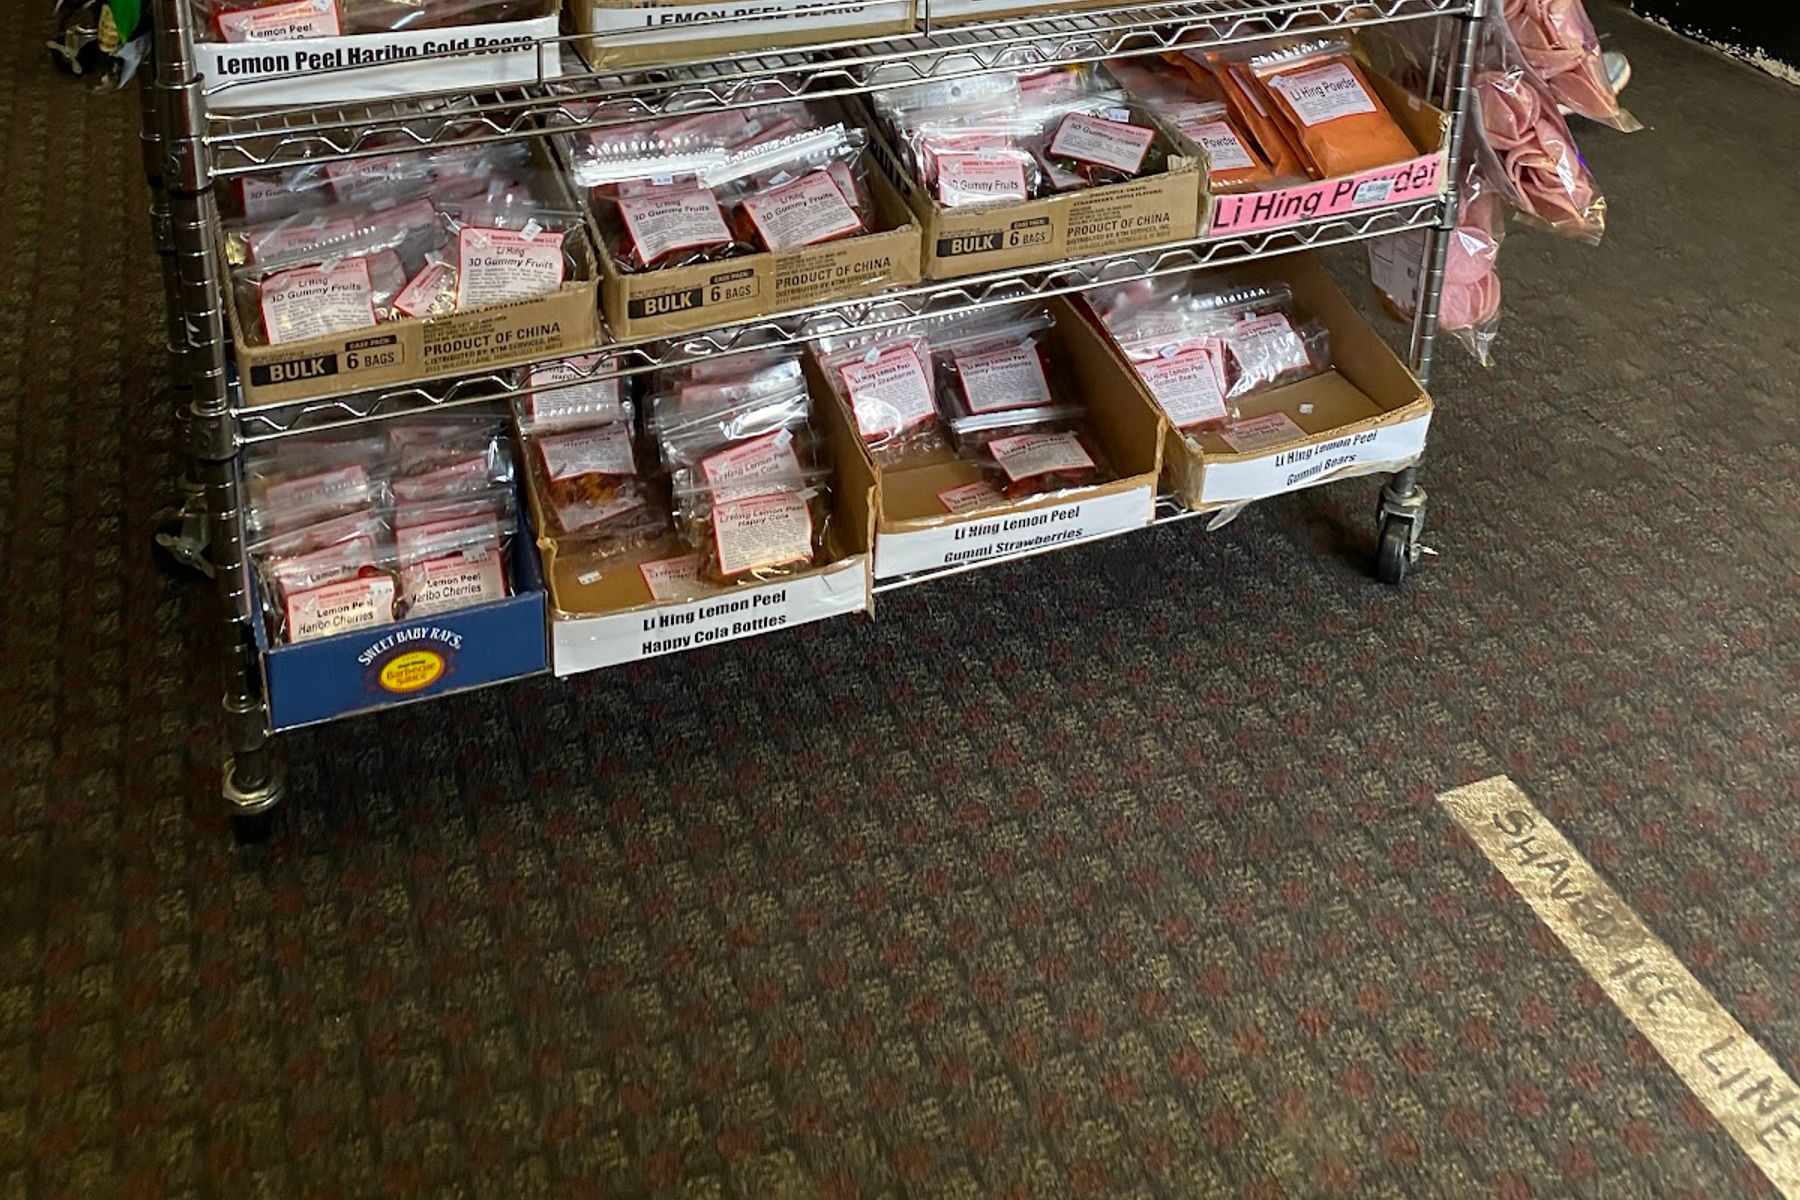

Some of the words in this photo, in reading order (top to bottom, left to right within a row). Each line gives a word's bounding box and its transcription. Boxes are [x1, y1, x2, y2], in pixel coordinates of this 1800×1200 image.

[250, 28, 288, 39] Lemon
[289, 22, 313, 35] Peel
[217, 53, 290, 75] Lemon
[295, 49, 344, 69] Peel
[348, 42, 417, 66] Haribo
[423, 38, 469, 58] Gold
[1290, 90, 1301, 101] Li
[1300, 85, 1325, 98] Hing
[1323, 77, 1357, 92] Powder
[1202, 136, 1237, 148] Powder
[960, 180, 993, 191] Gummy
[995, 181, 1018, 189] Fruits
[1212, 194, 1242, 229] Li
[1250, 190, 1322, 224] Hing
[1330, 161, 1441, 207] Pder
[648, 207, 682, 217] Gummy
[775, 202, 807, 216] Gummy
[809, 192, 833, 204] Fruits
[1067, 222, 1119, 237] PRODUCT
[1121, 219, 1134, 229] OF
[1137, 212, 1170, 227] CHINA
[506, 247, 525, 257] Hing
[951, 234, 994, 255] BULK
[1009, 231, 1019, 246] 6
[1022, 231, 1046, 245] BAGS
[468, 258, 481, 267] 3D
[484, 257, 523, 267] Gummy
[525, 257, 554, 269] Fruits
[776, 268, 832, 290] PRODUCT
[836, 265, 850, 276] OF
[854, 257, 891, 273] CHINA
[288, 287, 328, 300] Gummy
[331, 283, 361, 292] Fruits
[645, 292, 692, 315] BULK
[711, 286, 720, 302] 6
[726, 285, 751, 299] BAGS
[424, 335, 489, 357] PRODUCT
[495, 330, 513, 343] OF
[517, 322, 561, 340] CHINA
[269, 358, 326, 382] BULK
[347, 353, 359, 369] 6
[365, 352, 395, 367] BAGS
[1275, 455, 1284, 467] Li
[1287, 448, 1313, 463] Hing
[1314, 438, 1351, 455] Lemon
[1353, 429, 1378, 446] Peel
[745, 457, 772, 471] Lemon
[1286, 463, 1322, 486] Gummi
[1324, 454, 1357, 471] Bears
[753, 507, 783, 516] Lemon
[769, 513, 789, 521] Cola
[954, 528, 965, 541] Li
[968, 521, 1000, 538] Hing
[1003, 513, 1047, 531] Lemon
[1051, 506, 1080, 522] Peel
[944, 544, 992, 563] Gummi
[996, 527, 1083, 553] Strawberries
[310, 569, 339, 583] Lemon
[427, 578, 458, 588] Lemon
[460, 573, 481, 582] Peel
[443, 584, 482, 598] Cherries
[317, 605, 349, 618] Lemon
[643, 618, 655, 631] Li
[660, 611, 695, 628] Hing
[699, 600, 748, 619] Lemon
[753, 590, 786, 608] Peel
[642, 635, 690, 655] Happy
[694, 626, 729, 643] Cola
[732, 614, 786, 635] Bottles
[358, 636, 395, 667] SWEET
[397, 627, 429, 643] BABY
[1609, 957, 1684, 1017] ICE
[1700, 1034, 1800, 1153] LINE
